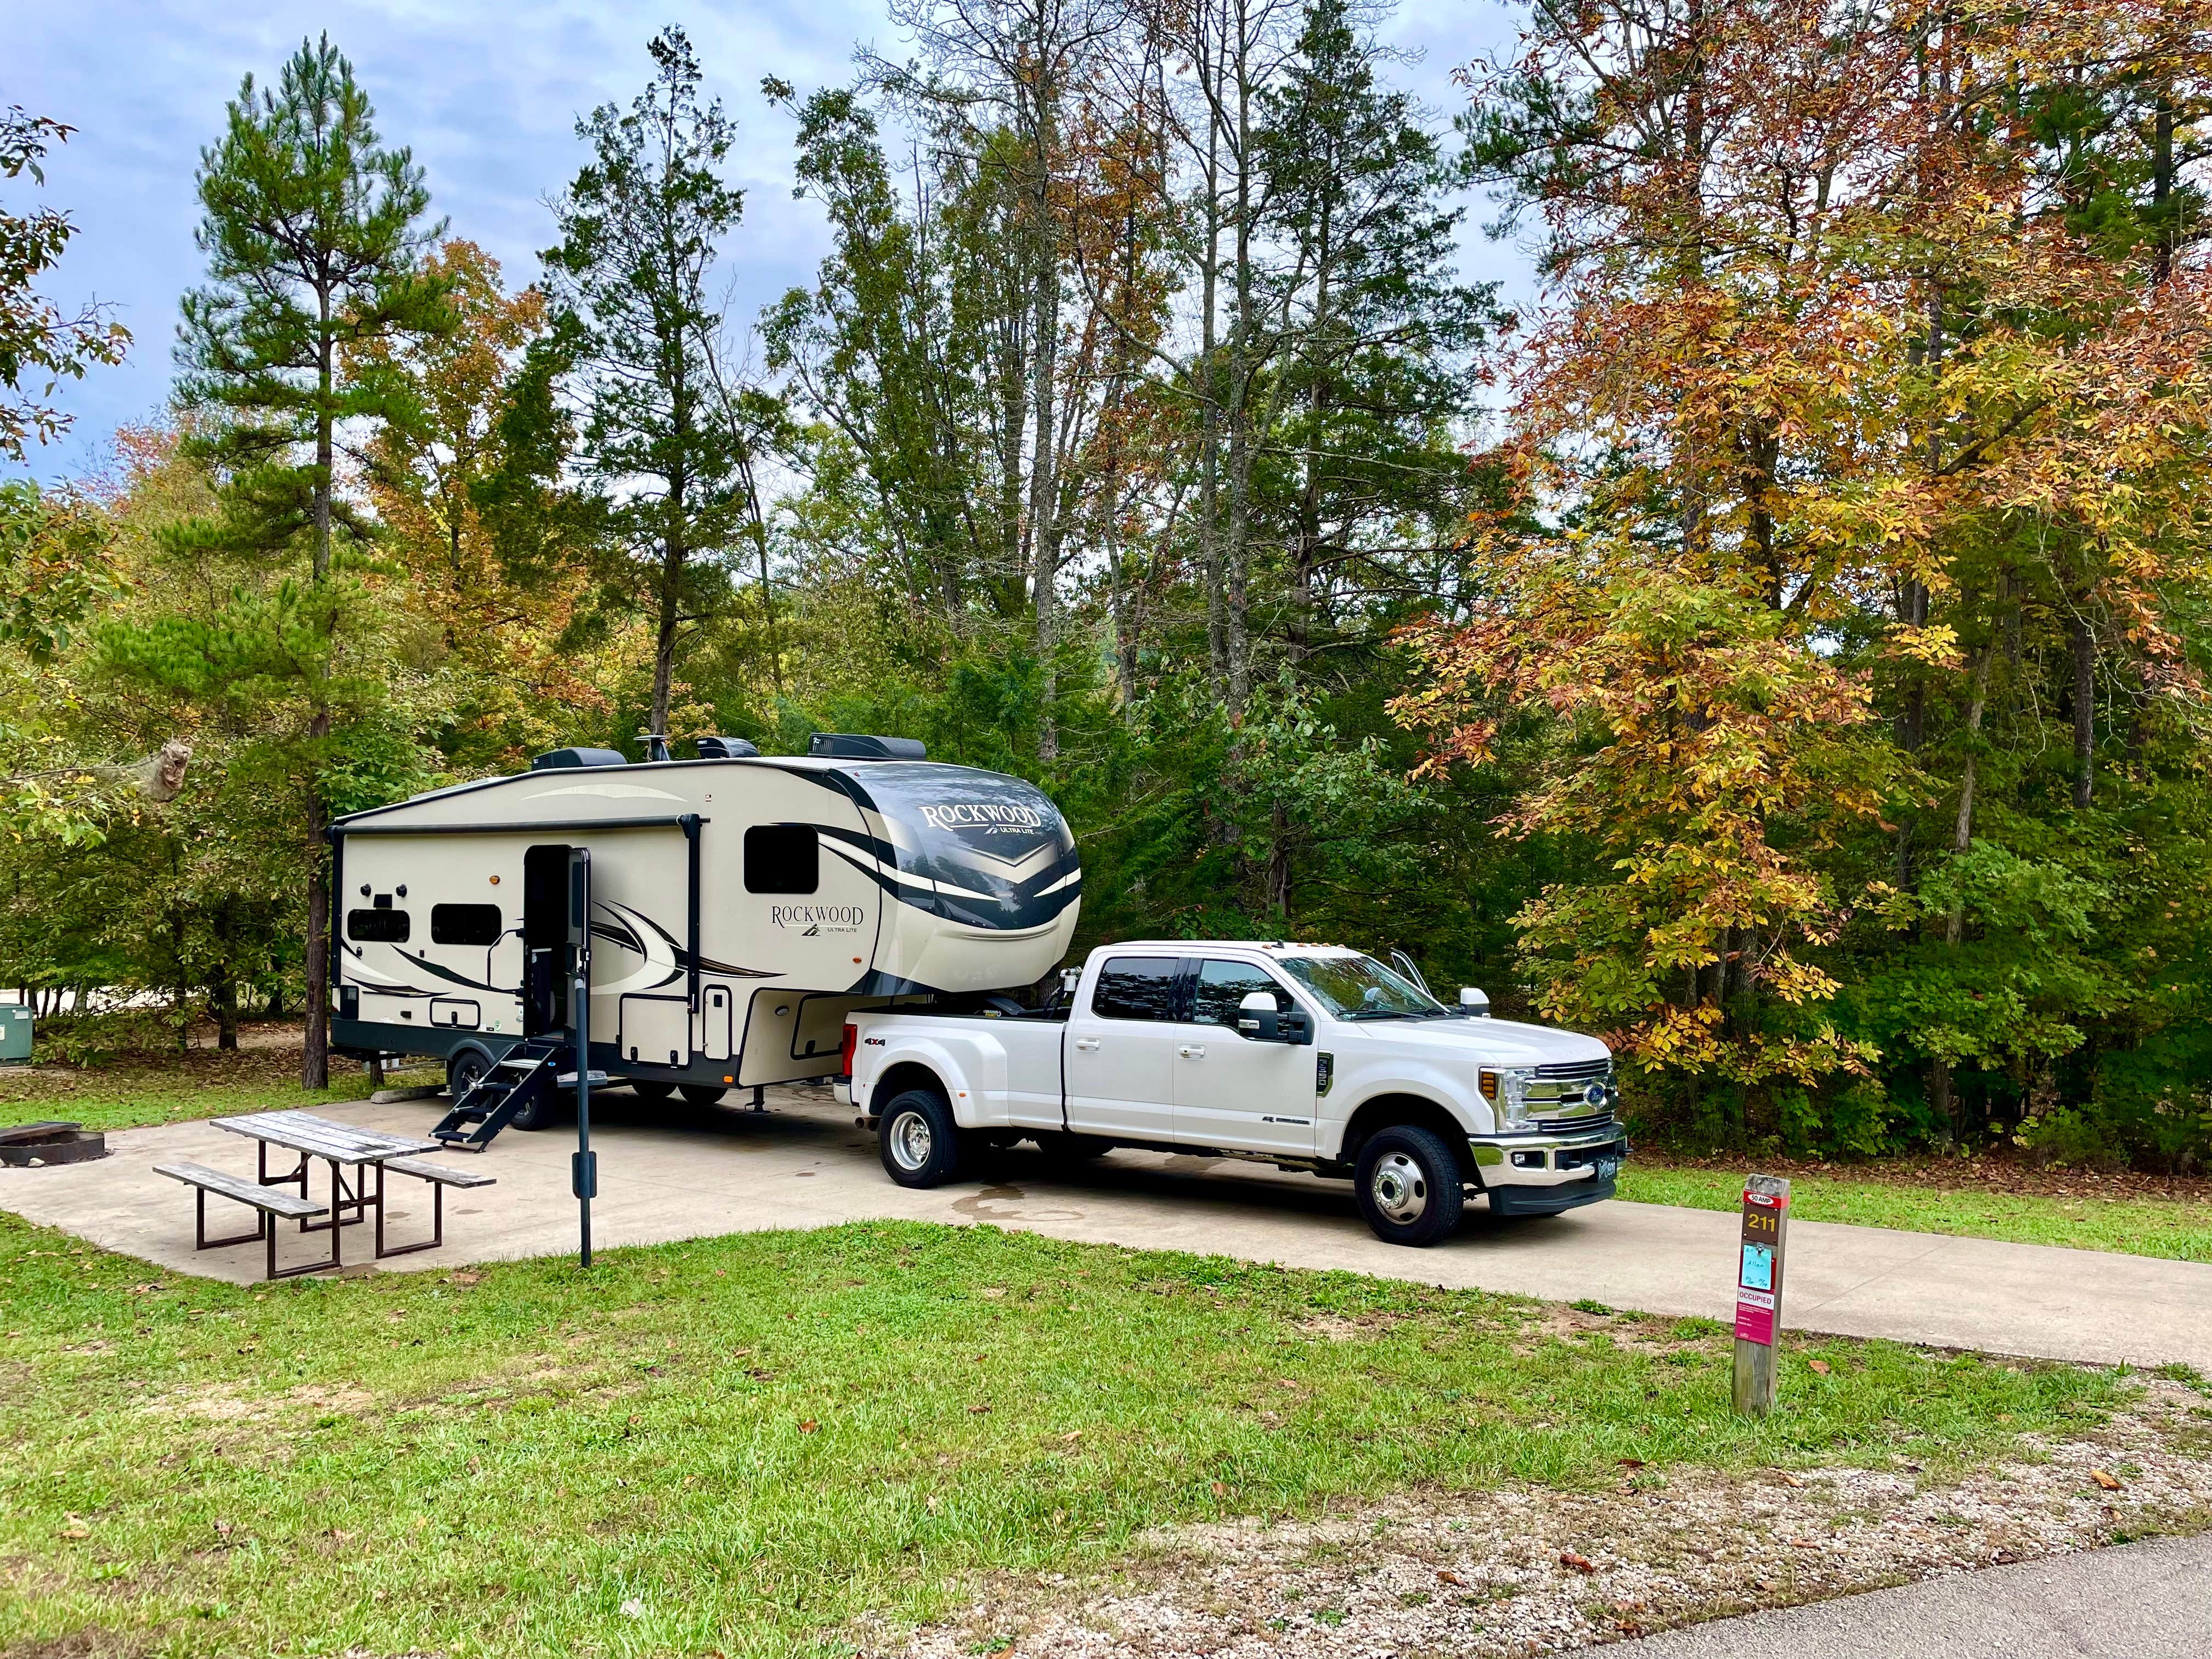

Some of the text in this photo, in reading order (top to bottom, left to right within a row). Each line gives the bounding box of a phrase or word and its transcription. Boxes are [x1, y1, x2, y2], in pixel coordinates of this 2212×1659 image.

[919, 804, 1041, 831] ROCKWOOD
[771, 906, 864, 929] ROCKWOOD
[1748, 1213, 1775, 1232] 211
[1740, 1291, 1771, 1304] OCCUPIED
